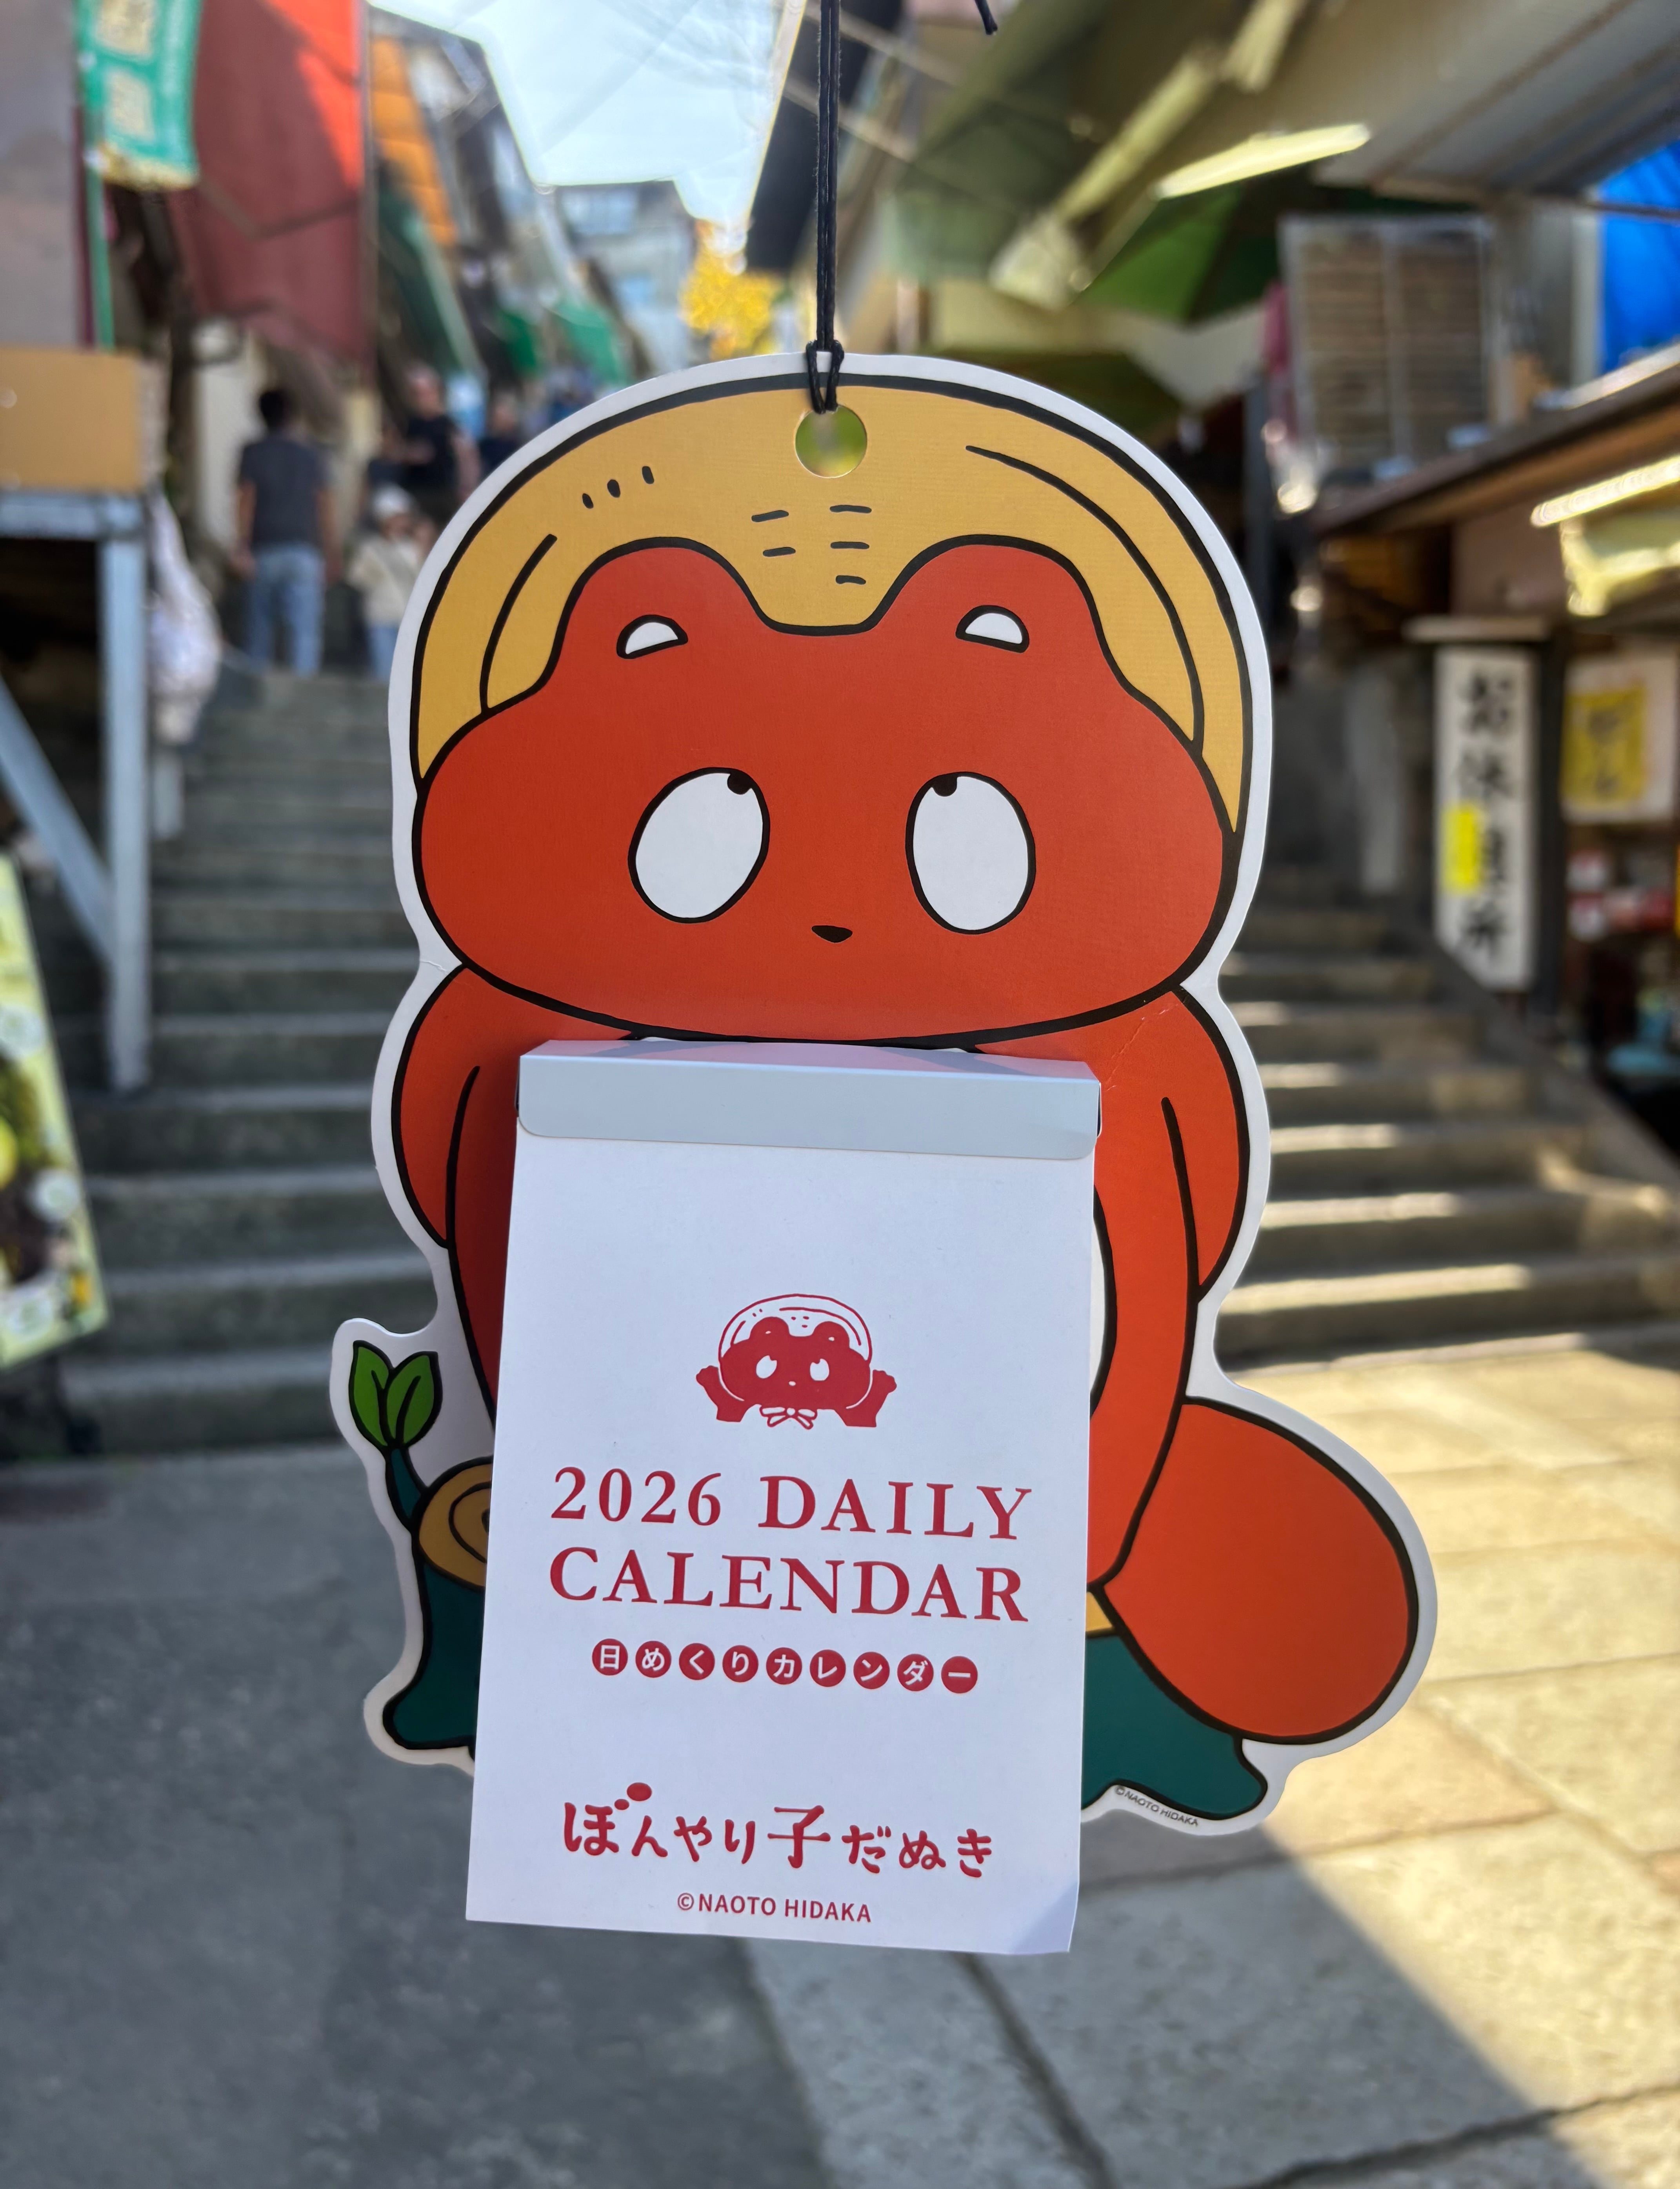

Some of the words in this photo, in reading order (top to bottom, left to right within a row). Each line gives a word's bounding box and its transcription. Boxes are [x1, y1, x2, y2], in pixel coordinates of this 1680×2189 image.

[551, 1467, 721, 1526] 2026
[758, 1476, 1031, 1540] DAILY
[549, 1547, 1028, 1622] CALENDAR
[597, 1644, 973, 1689] 日めくりカレンダー
[564, 1783, 992, 1878] ぼんやり子だぬき
[1160, 1809, 1198, 1825] HIDAKA
[784, 1899, 871, 1922] HIDAKA
